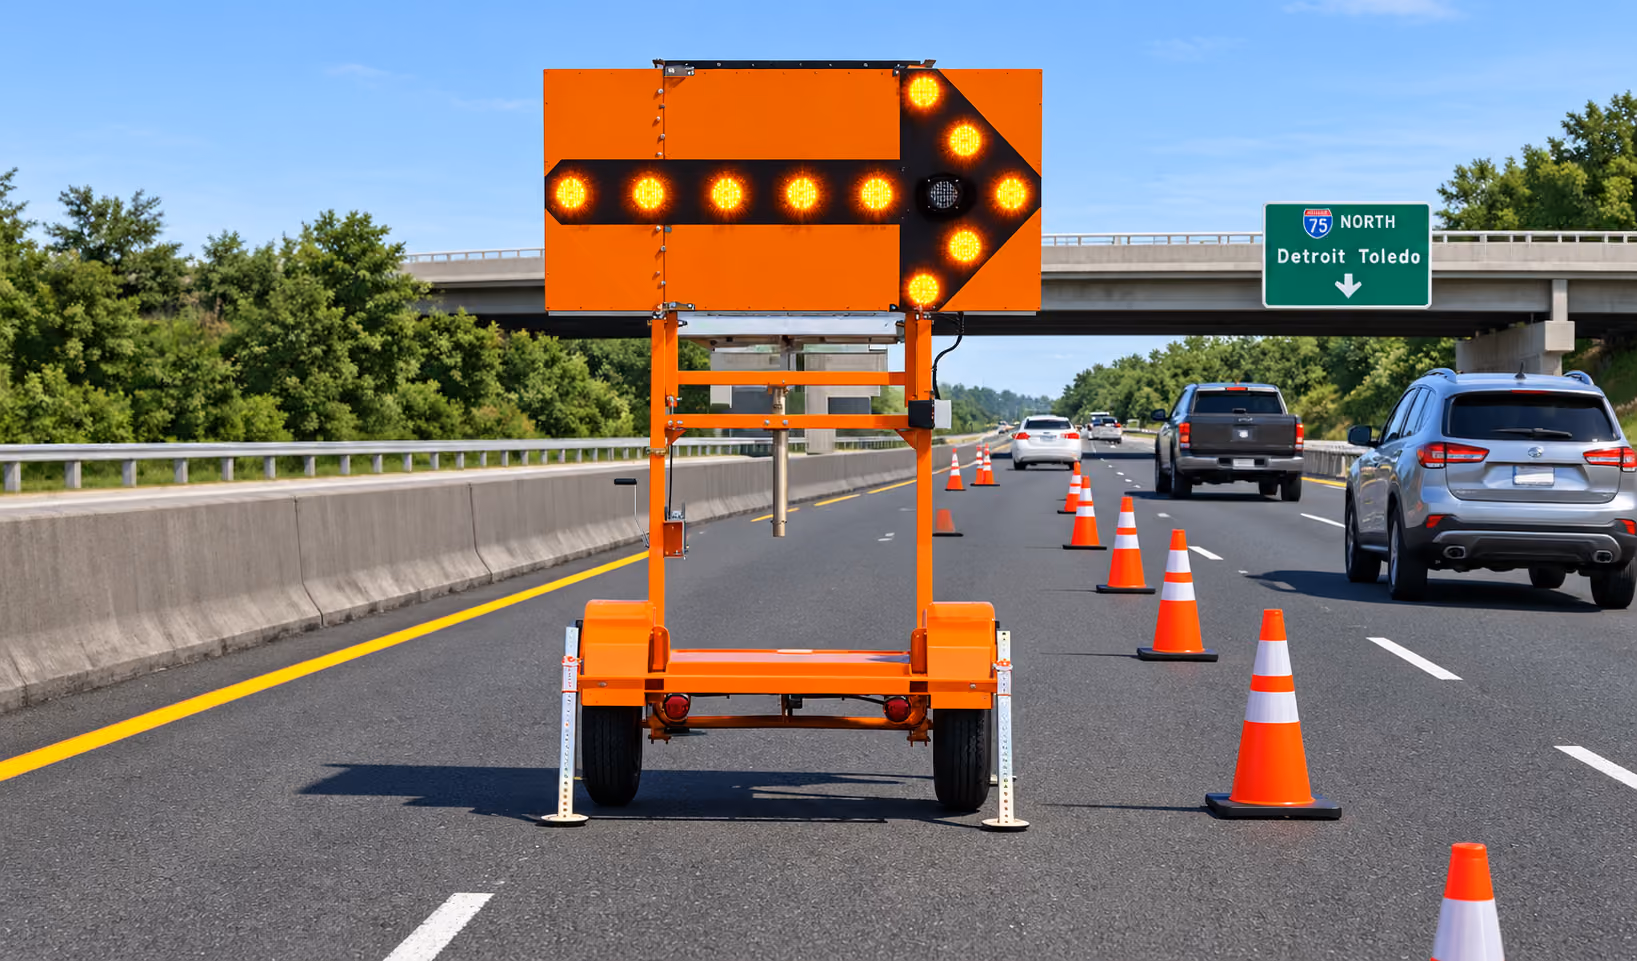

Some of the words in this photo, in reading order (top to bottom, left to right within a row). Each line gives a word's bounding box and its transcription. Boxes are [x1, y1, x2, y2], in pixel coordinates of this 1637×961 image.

[1309, 218, 1328, 233] 75
[1340, 215, 1396, 229] NORTH
[1277, 248, 1346, 264] Detroit
[1358, 248, 1421, 264] Toledo
